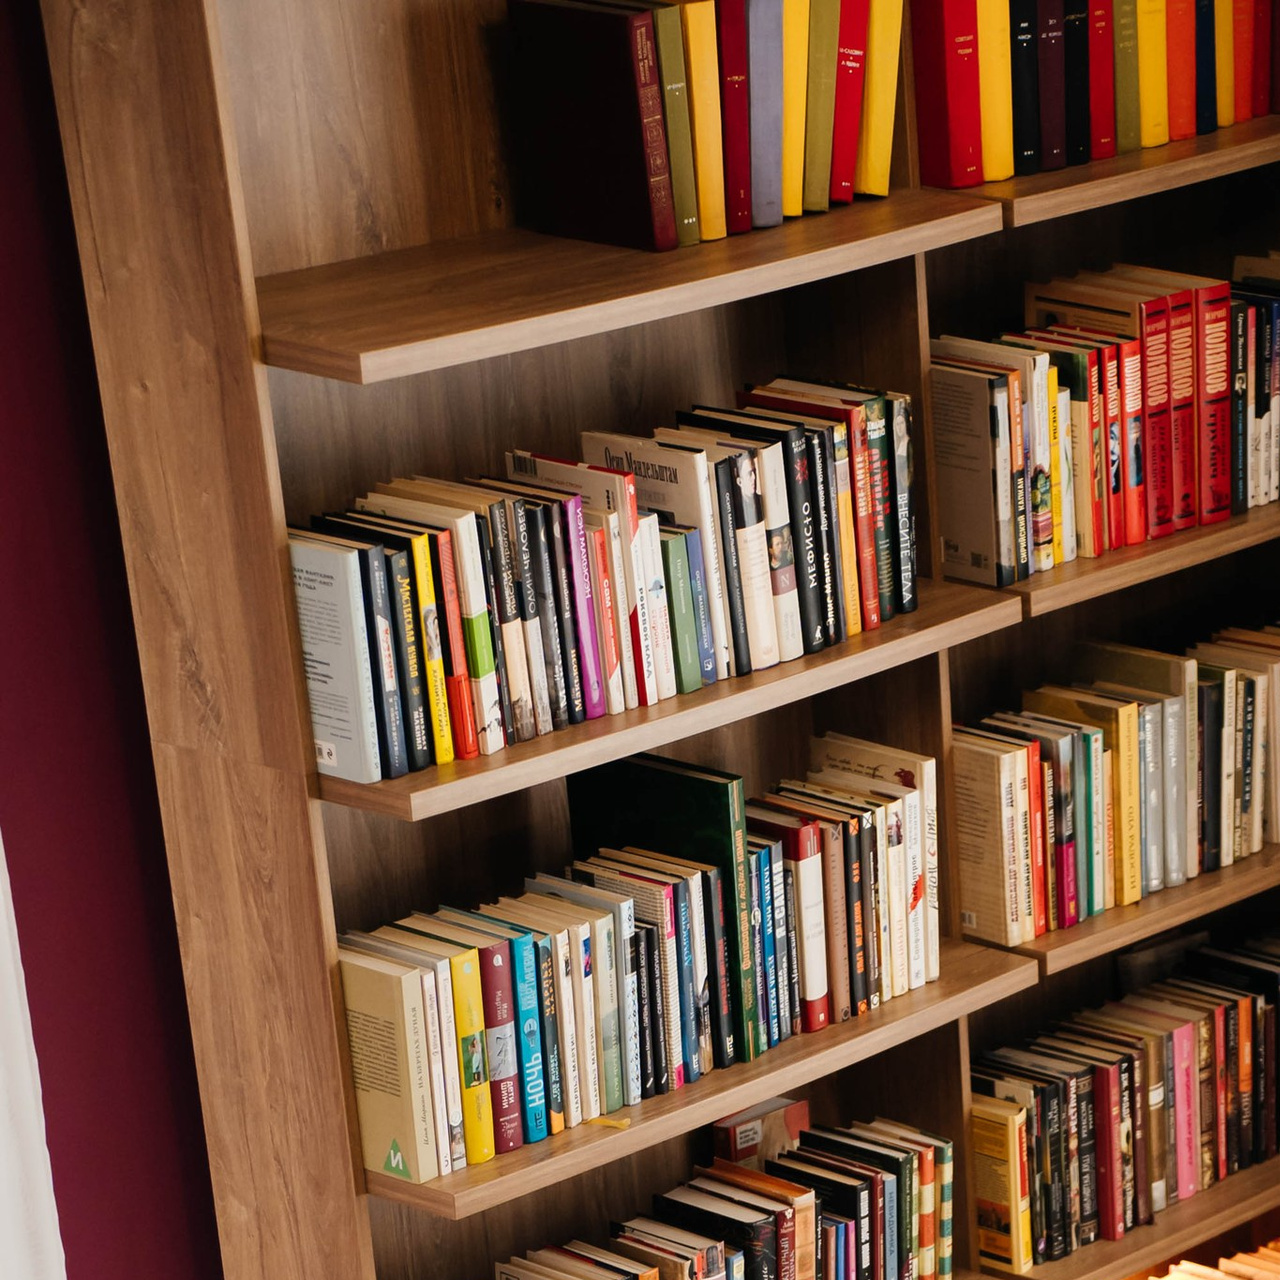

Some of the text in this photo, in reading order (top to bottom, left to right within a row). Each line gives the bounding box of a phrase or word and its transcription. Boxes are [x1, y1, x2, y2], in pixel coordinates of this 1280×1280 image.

[1123, 355, 1142, 412] ПОЛЯКОВ
[1144, 332, 1167, 406] ПОЛЯКОВ
[1172, 328, 1192, 400] ПОЛЯКОВ
[1206, 322, 1227, 394] ПОЛЯКОВ
[1090, 364, 1099, 422] ПОЛЯКОВ
[1107, 359, 1118, 417] ПОЛЯКОВ
[625, 451, 678, 484] Мандельштам
[723, 491, 732, 513] ОСИП
[1015, 477, 1028, 563] СИРИЙСКИЙ КАПКАН
[497, 508, 511, 560] прогулка
[516, 506, 537, 613] ОДИН ЧЕЛОВЕК
[575, 507, 591, 598] ИЭН МАКЬЮЭН
[726, 512, 738, 567] МАНДЕЛЬШТАМ
[801, 501, 817, 588] МЕФИСТО
[896, 493, 914, 603] ВНЕСИТЕ ТЕЛА
[694, 570, 710, 649] ОСИП МАНДЕЛЬШТАМ
[821, 552, 835, 626] Элис Манро
[406, 645, 419, 678] КУКОЛ
[1004, 815, 1017, 866] ПРОХАНОВ
[1019, 810, 1030, 859] ПРОХАНОВ
[1127, 833, 1136, 889] РАДОСТИ
[1007, 868, 1020, 922] АЛЕКСАНДР
[1021, 861, 1033, 916] АЛЕКСАНДР
[494, 989, 503, 1020] Мартин
[541, 961, 552, 1016] ЧАРЛЬЗ
[546, 957, 556, 1013] МАРТИН
[413, 1037, 423, 1074] БЕРЕГАХ
[568, 1031, 578, 1071] МАРТИН
[587, 1025, 597, 1065] МАРТИН
[417, 1075, 424, 1088] НА
[522, 1052, 546, 1108] НОЧЬ
[887, 1191, 895, 1255] НЕВИДИМКА
